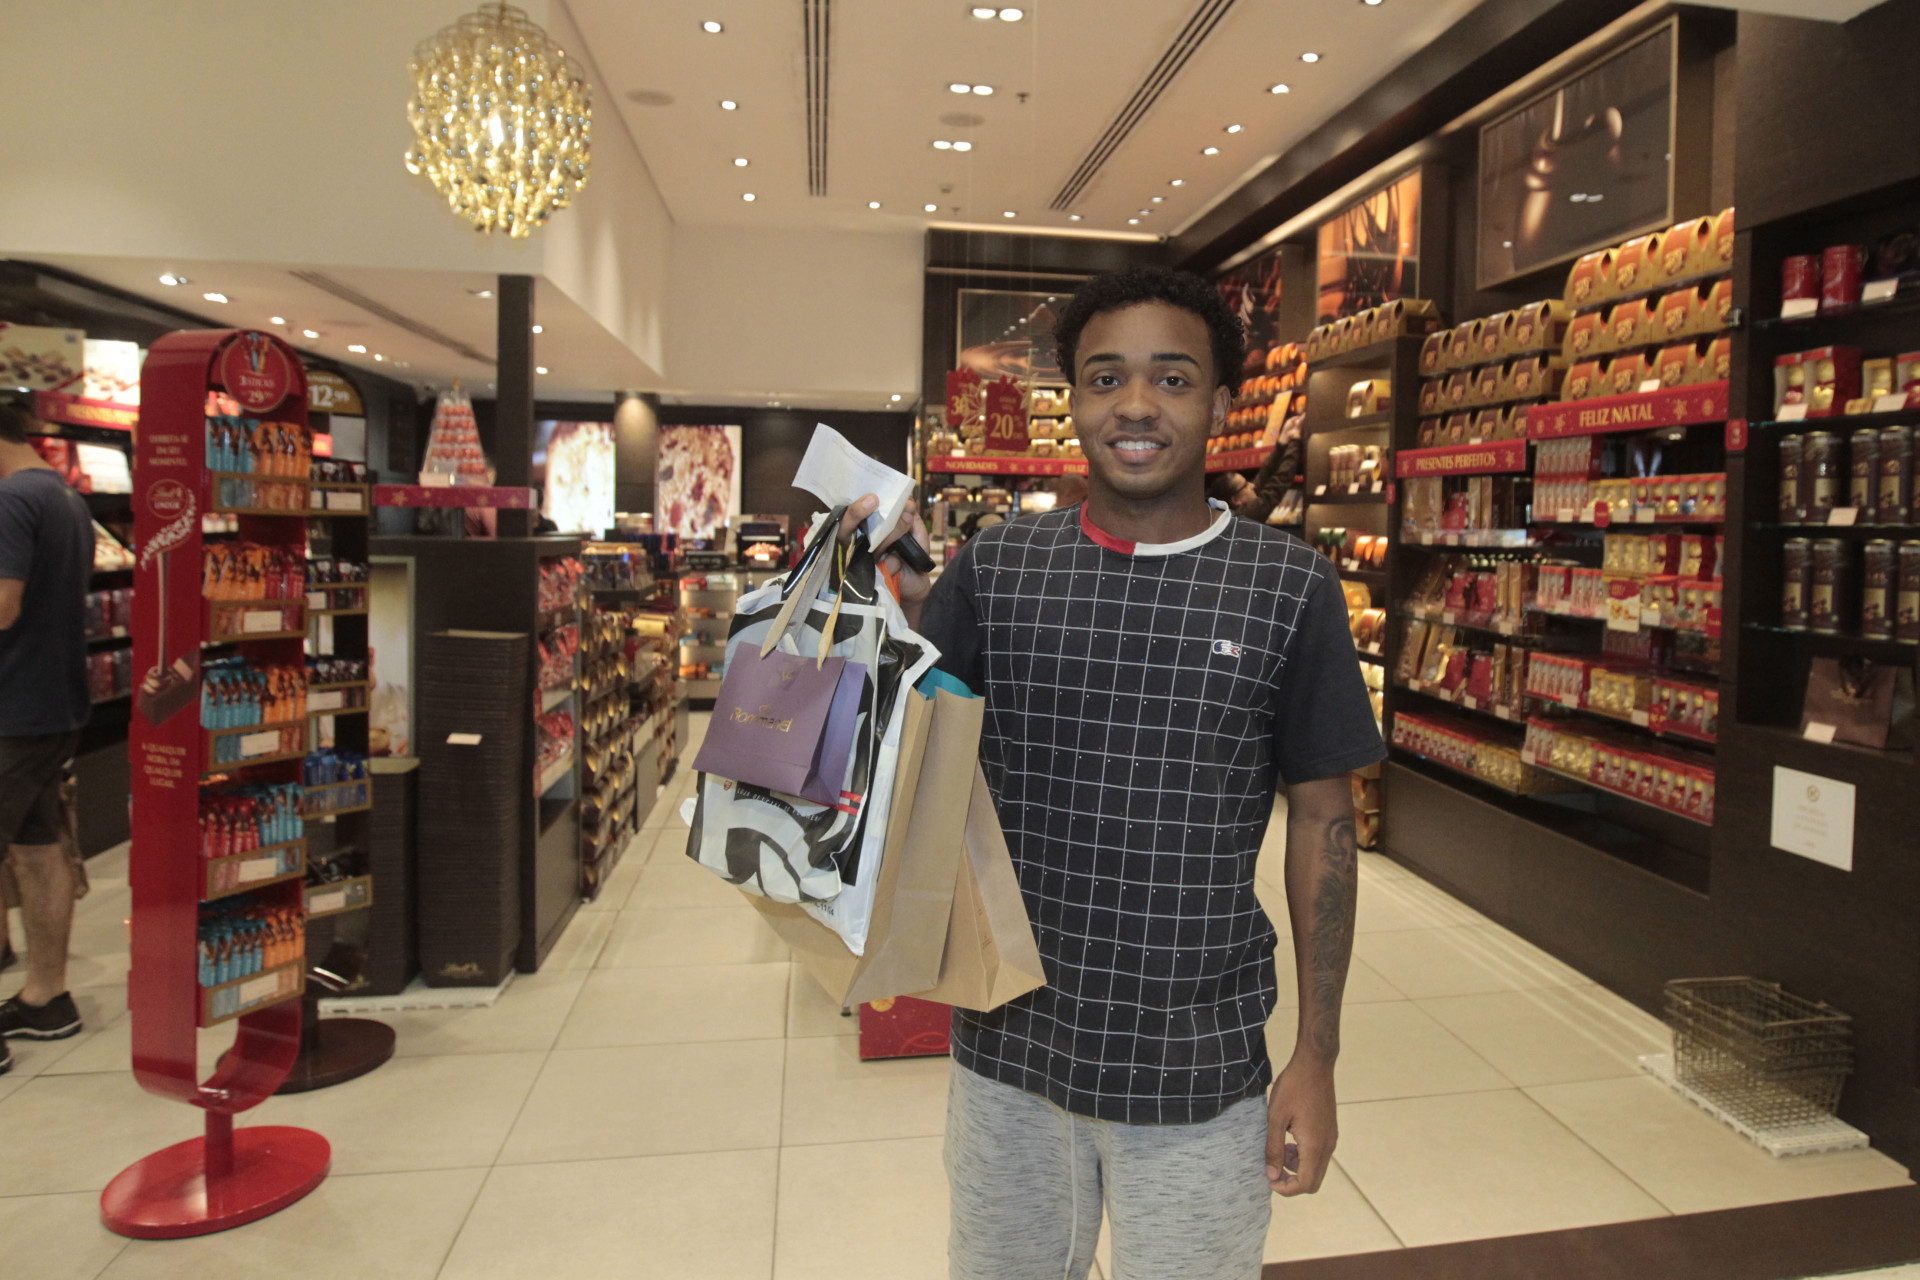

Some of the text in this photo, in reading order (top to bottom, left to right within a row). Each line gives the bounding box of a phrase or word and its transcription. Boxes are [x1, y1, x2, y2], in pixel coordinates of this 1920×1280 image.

[989, 412, 1014, 439] 20
[1579, 403, 1654, 427] FELIZ NATAL
[945, 460, 999, 471] NOVIDADES
[1063, 463, 1086, 473] FELIZ
[1416, 451, 1497, 472] PRESENTES PERFEITOS
[729, 706, 793, 733] Rommanel
